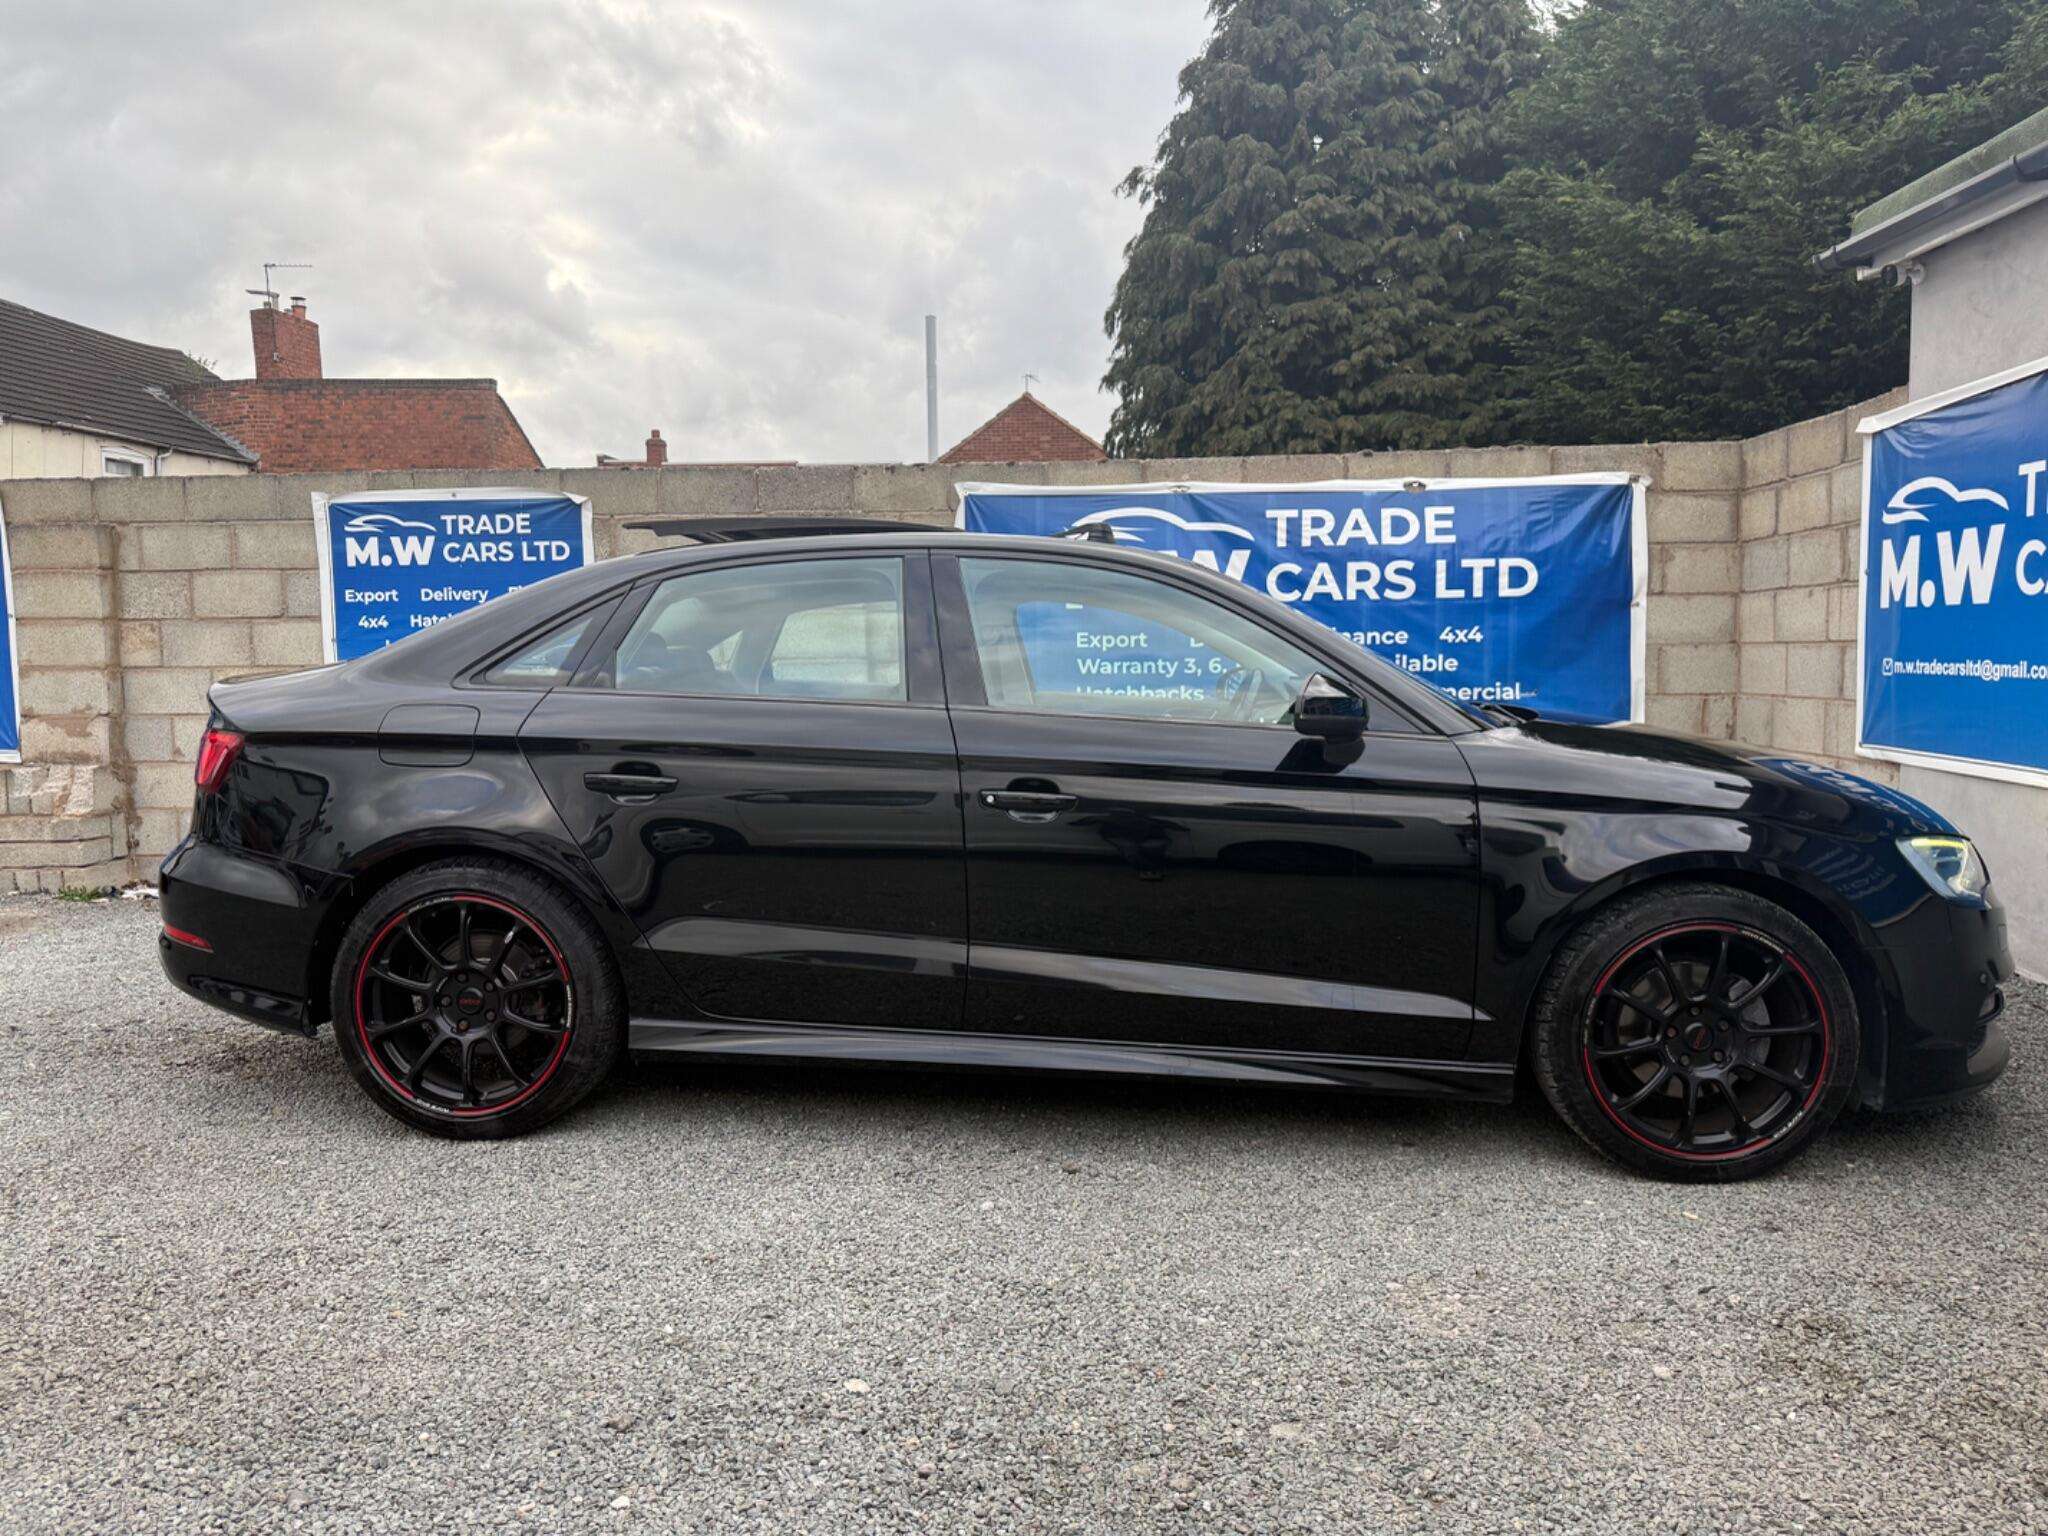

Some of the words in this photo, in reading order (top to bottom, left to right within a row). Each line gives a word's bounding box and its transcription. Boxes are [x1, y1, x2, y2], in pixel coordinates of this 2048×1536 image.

[2018, 459, 2048, 518] T
[440, 514, 531, 535] TRADE
[1266, 506, 1456, 548] TRADE
[345, 535, 436, 567] M.W
[443, 541, 514, 562] CARS
[521, 540, 570, 562] LTD
[1879, 523, 2006, 609] M.W
[1265, 559, 1416, 602] CARS
[1435, 557, 1539, 600] LTD
[344, 589, 399, 605] Export
[420, 587, 489, 604] Delivery
[358, 614, 389, 629] 4x4
[410, 614, 461, 628] Hat
[1076, 631, 1148, 652] Export
[1333, 626, 1409, 646] nance
[1438, 625, 1484, 644] 4x4
[1077, 657, 1179, 679] Warranty
[1394, 653, 1459, 672] ilable
[1894, 657, 2048, 682] m.w.tradecarsltd@gmail.co
